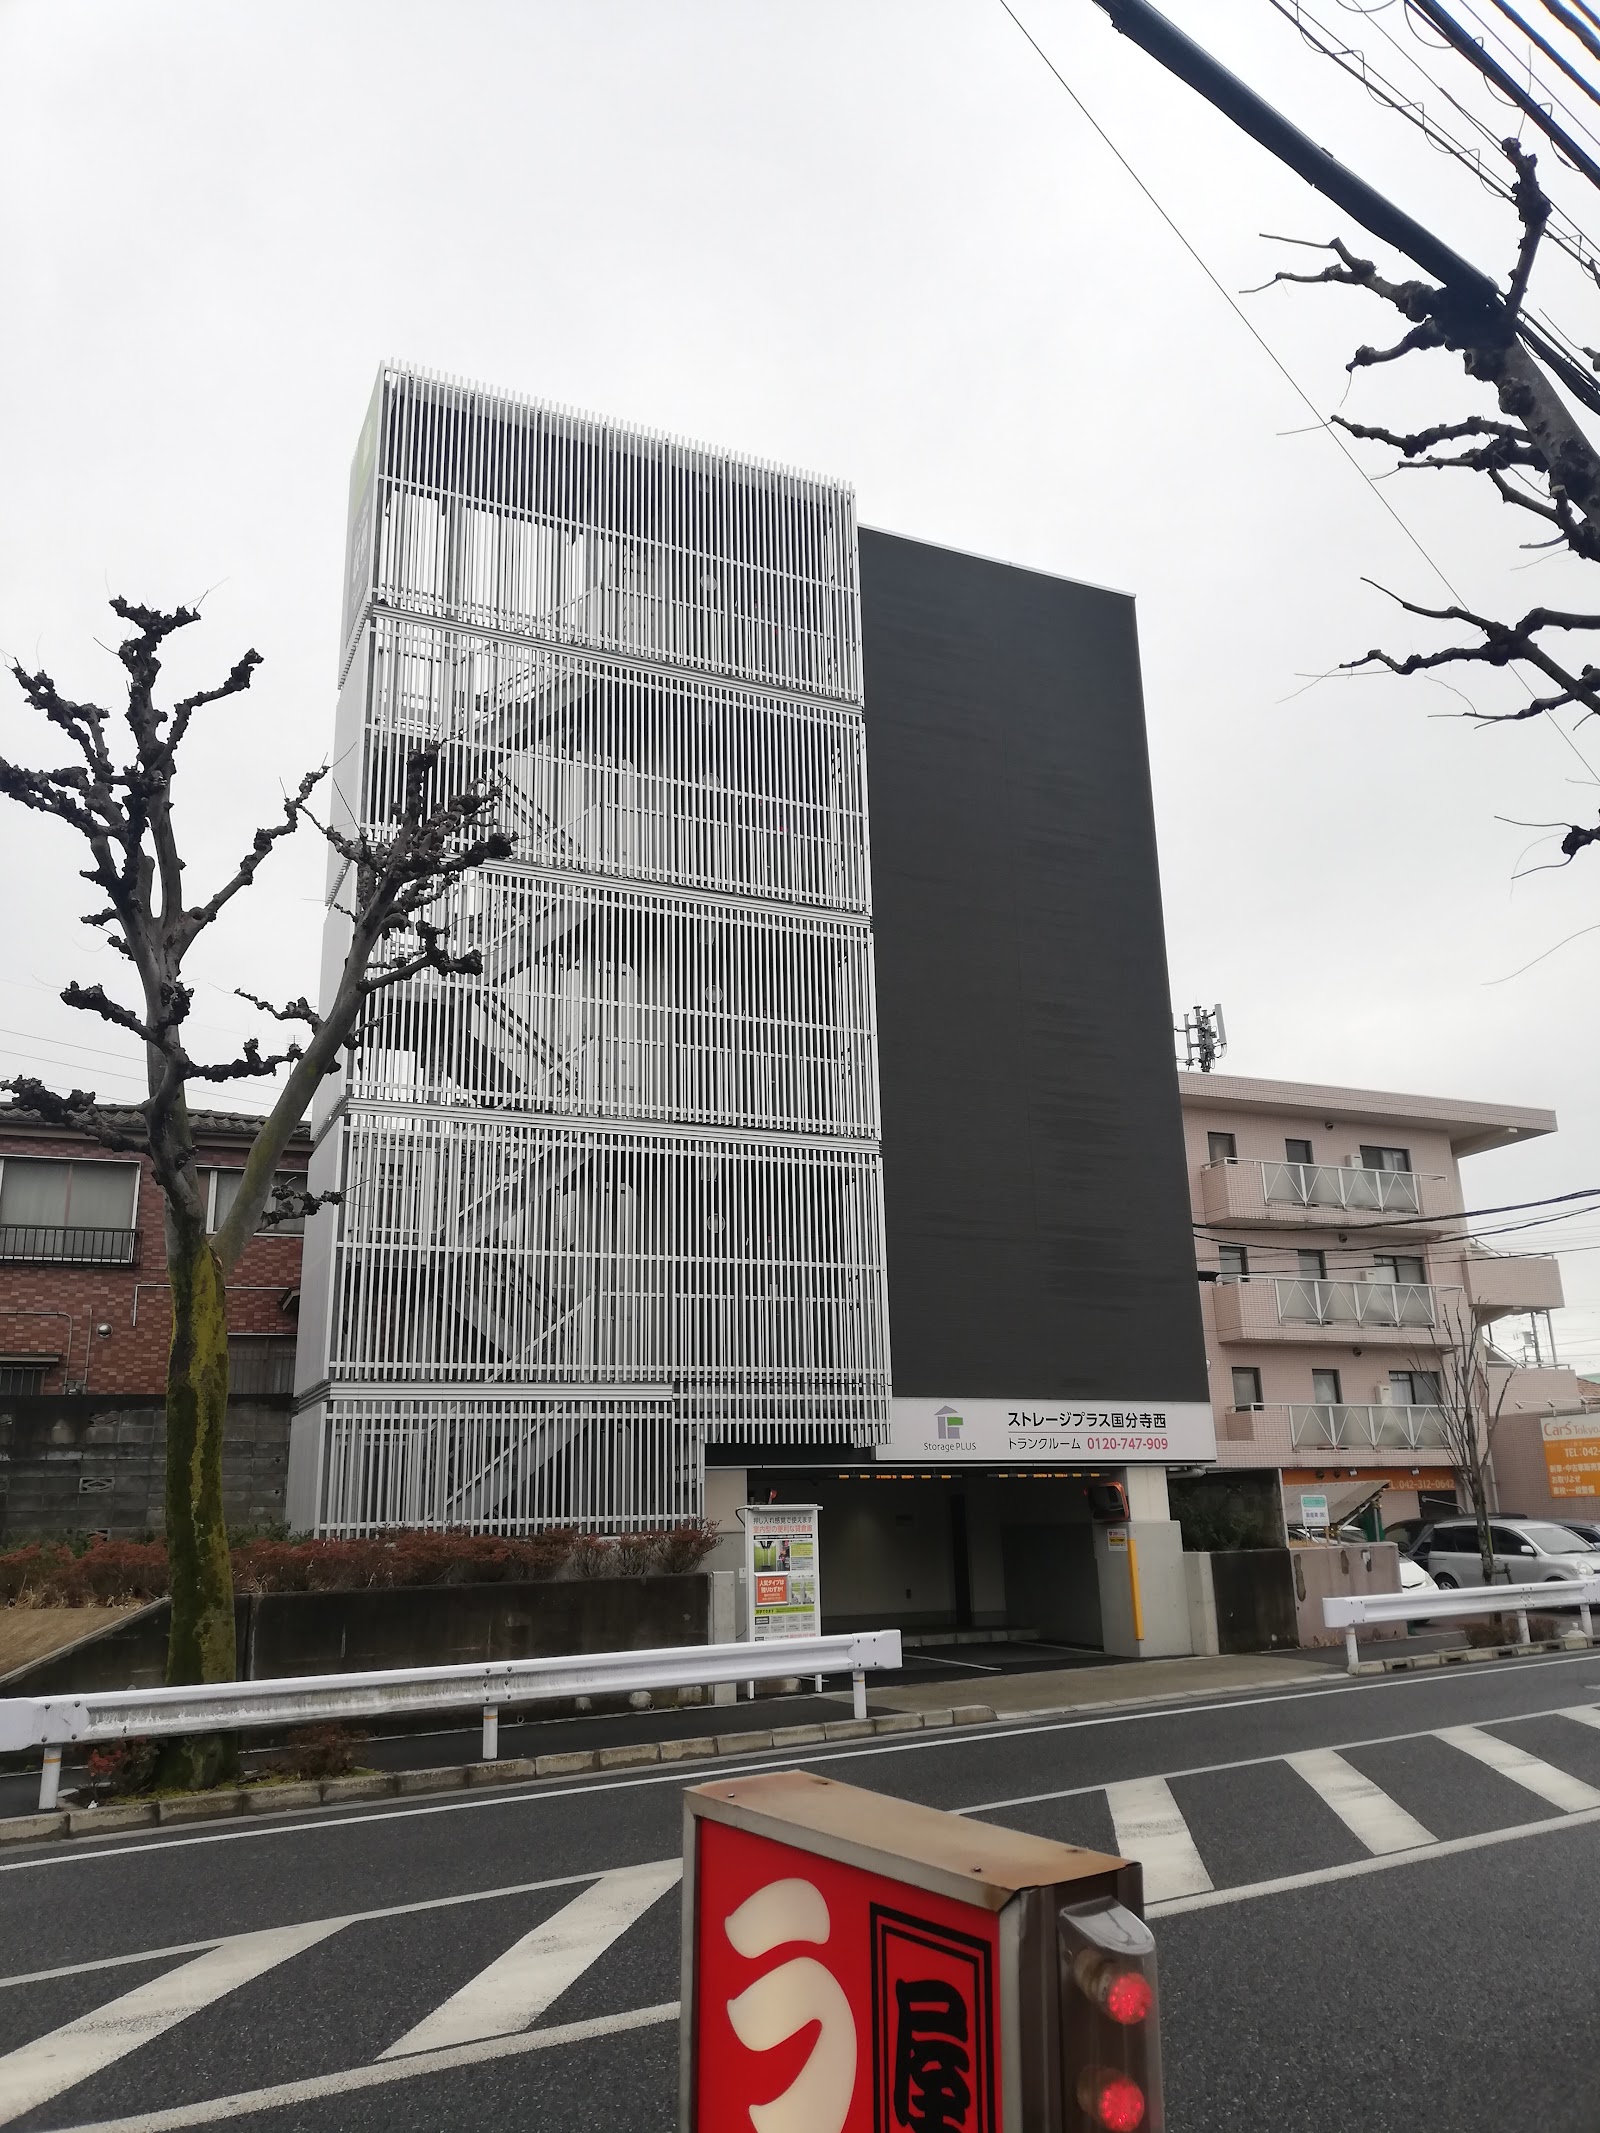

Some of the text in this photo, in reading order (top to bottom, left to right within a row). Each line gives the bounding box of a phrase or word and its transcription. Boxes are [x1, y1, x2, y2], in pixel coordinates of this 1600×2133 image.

[1008, 1411, 1167, 1429] ストレージプラス国分寺西
[923, 1442, 977, 1453] Storage PLUS
[1009, 1437, 1168, 1450] トランクルーム 0120-747-909
